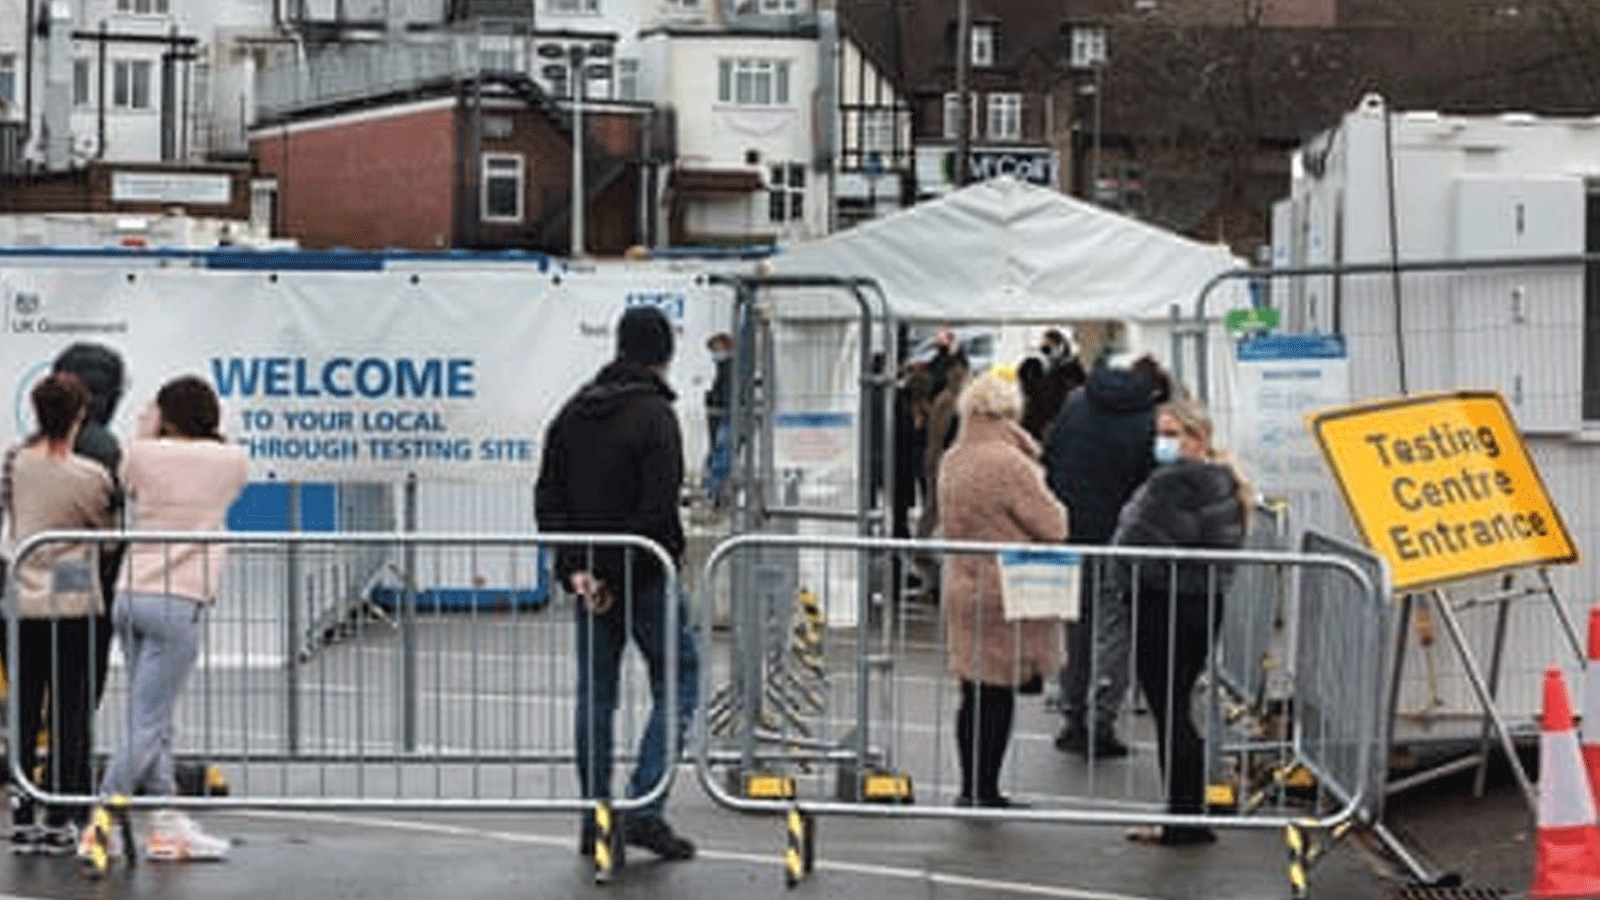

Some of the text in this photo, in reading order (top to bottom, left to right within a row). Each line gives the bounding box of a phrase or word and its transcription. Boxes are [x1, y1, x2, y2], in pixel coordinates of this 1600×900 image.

[211, 357, 476, 398] WELCOME
[241, 409, 447, 433] TO YOUR LOCAL
[364, 438, 472, 461] TESTING
[479, 438, 533, 461] SITE
[1364, 422, 1501, 468] Testing
[1391, 467, 1515, 512] Centre
[1387, 511, 1548, 561] Entrance
